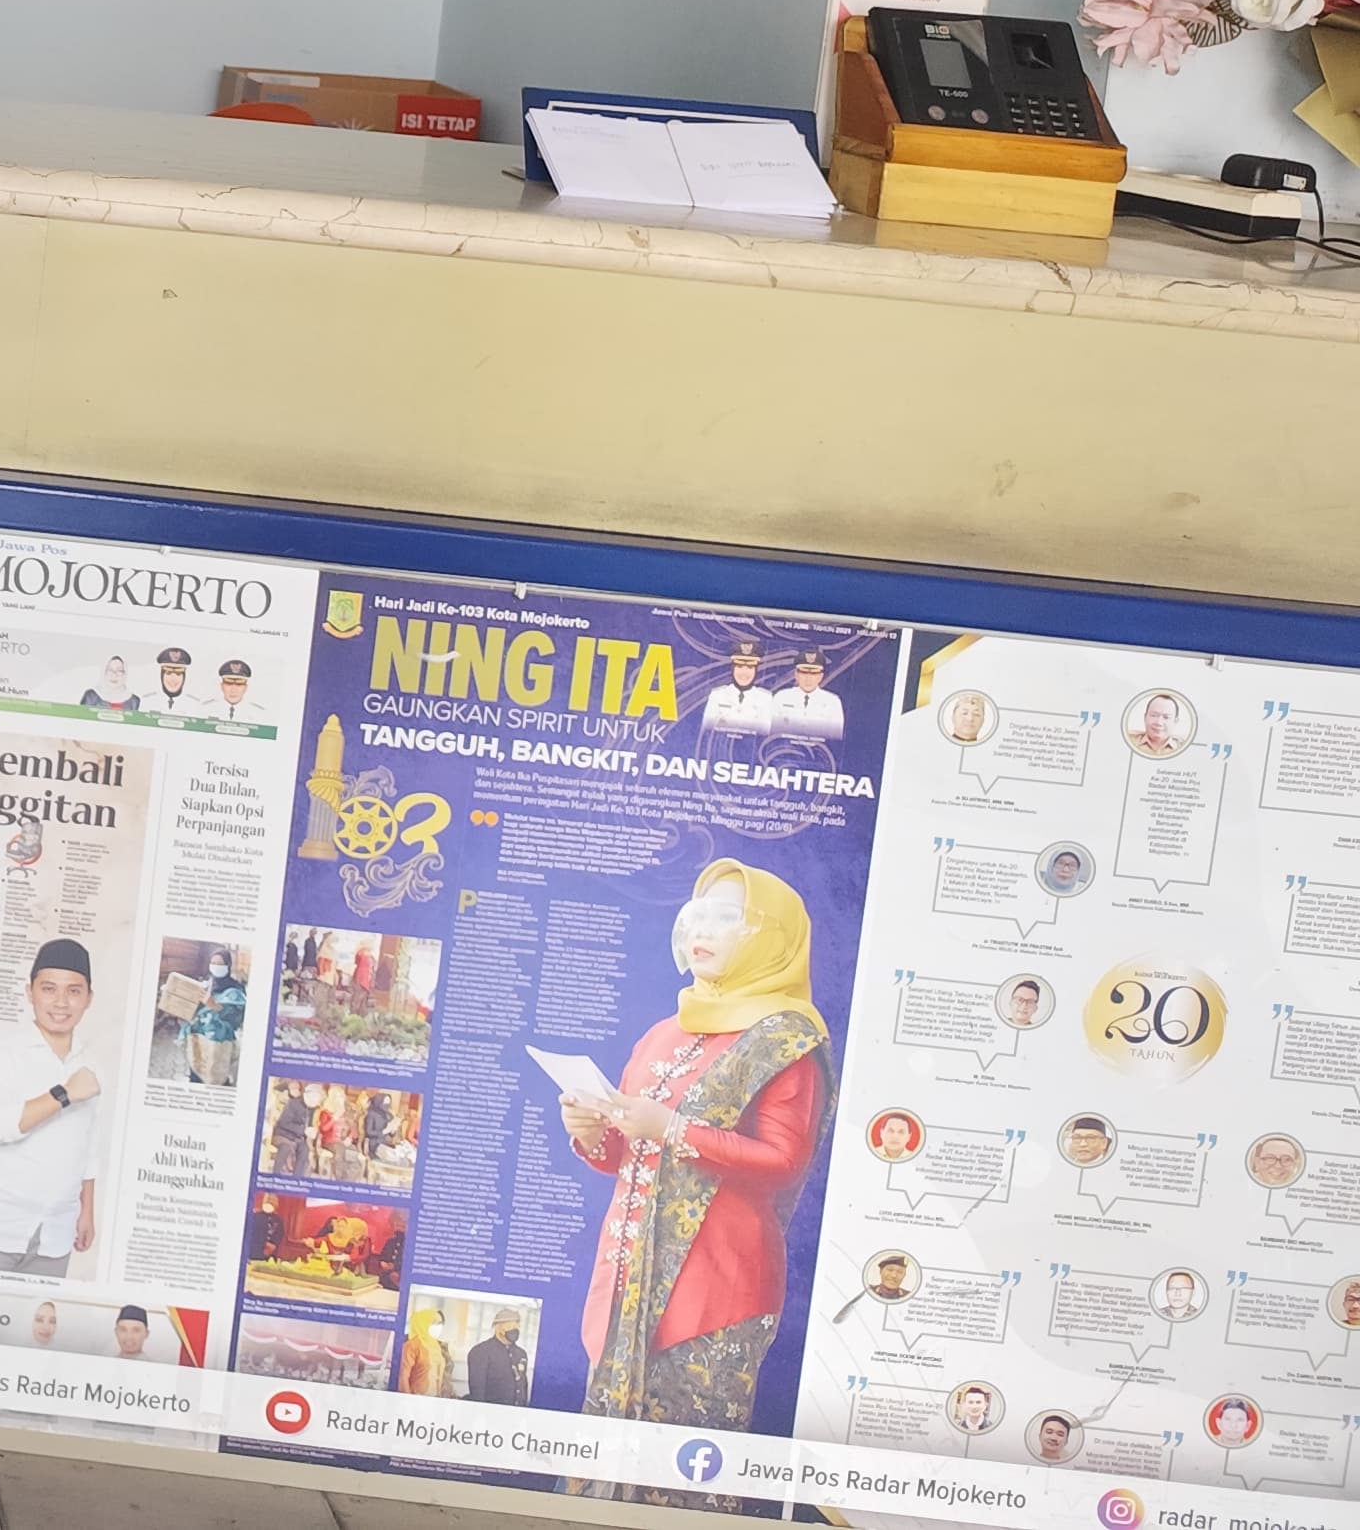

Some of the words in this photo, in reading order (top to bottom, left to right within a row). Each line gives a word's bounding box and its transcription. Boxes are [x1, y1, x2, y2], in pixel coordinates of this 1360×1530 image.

[401, 113, 422, 128] ISI
[427, 115, 475, 132] TETAP
[41, 543, 68, 555] Pos
[375, 596, 403, 611] Hari
[406, 600, 434, 613] Jadi
[438, 602, 484, 618] Ke-103
[487, 608, 517, 621] Kota
[521, 610, 589, 630] Mojokerto
[370, 615, 555, 706] NING
[568, 637, 678, 722] ITA
[363, 694, 501, 726] GAUNGKAN
[507, 708, 577, 734] SPIRIT
[583, 720, 667, 744] UNTUK
[205, 761, 249, 778] Tersisa
[360, 723, 505, 763] TANGGUH,
[511, 740, 638, 776] BANGKIT,
[646, 754, 707, 781] DAN
[713, 761, 875, 798] SEJAHTERA
[190, 778, 216, 793] Dua
[219, 780, 260, 799] Bulan,
[475, 779, 491, 789] dan
[537, 785, 579, 798] Semangat
[607, 791, 628, 804] yang
[630, 795, 681, 812] digaungkan
[683, 798, 703, 812] Ning
[780, 811, 797, 821] wali
[800, 812, 822, 825] kota,
[824, 816, 845, 827] pada
[476, 767, 494, 778] Wali
[496, 769, 516, 780] Kota
[518, 771, 530, 781] Ika
[659, 788, 690, 800] elemen
[692, 789, 742, 805] masyarakat
[744, 795, 768, 807] untuk
[771, 799, 808, 812] tangguh,
[811, 803, 846, 816] bangkit,
[181, 797, 232, 816] Siapkan
[236, 803, 264, 819] Opsi
[473, 791, 521, 803] momentum
[524, 795, 569, 809] peringatan
[571, 799, 588, 810] Hari
[591, 801, 609, 813] Jadi
[611, 803, 640, 816] Ke-103
[642, 808, 661, 818] Kota
[664, 809, 709, 824] Mojokerto,
[711, 813, 743, 828] Minggu
[745, 818, 765, 831] pagi
[176, 815, 265, 838] Perpanjangan
[1105, 980, 1210, 1047] 20
[1129, 1048, 1175, 1062] TAHUN
[164, 1133, 206, 1151] Usulan
[152, 1152, 177, 1167] Ahli
[180, 1154, 214, 1171] Waris
[137, 1168, 224, 1191] Ditangguhkan
[17, 1375, 78, 1399] Radar
[85, 1383, 190, 1414] Mojokerto
[327, 1411, 388, 1435] Radar
[397, 1419, 503, 1448] Mojokerto
[512, 1432, 599, 1460] Channel
[737, 1458, 793, 1482] Jawa
[802, 1465, 839, 1487] Pos
[846, 1471, 910, 1495] Radar
[917, 1478, 1026, 1509] Mojokerto
